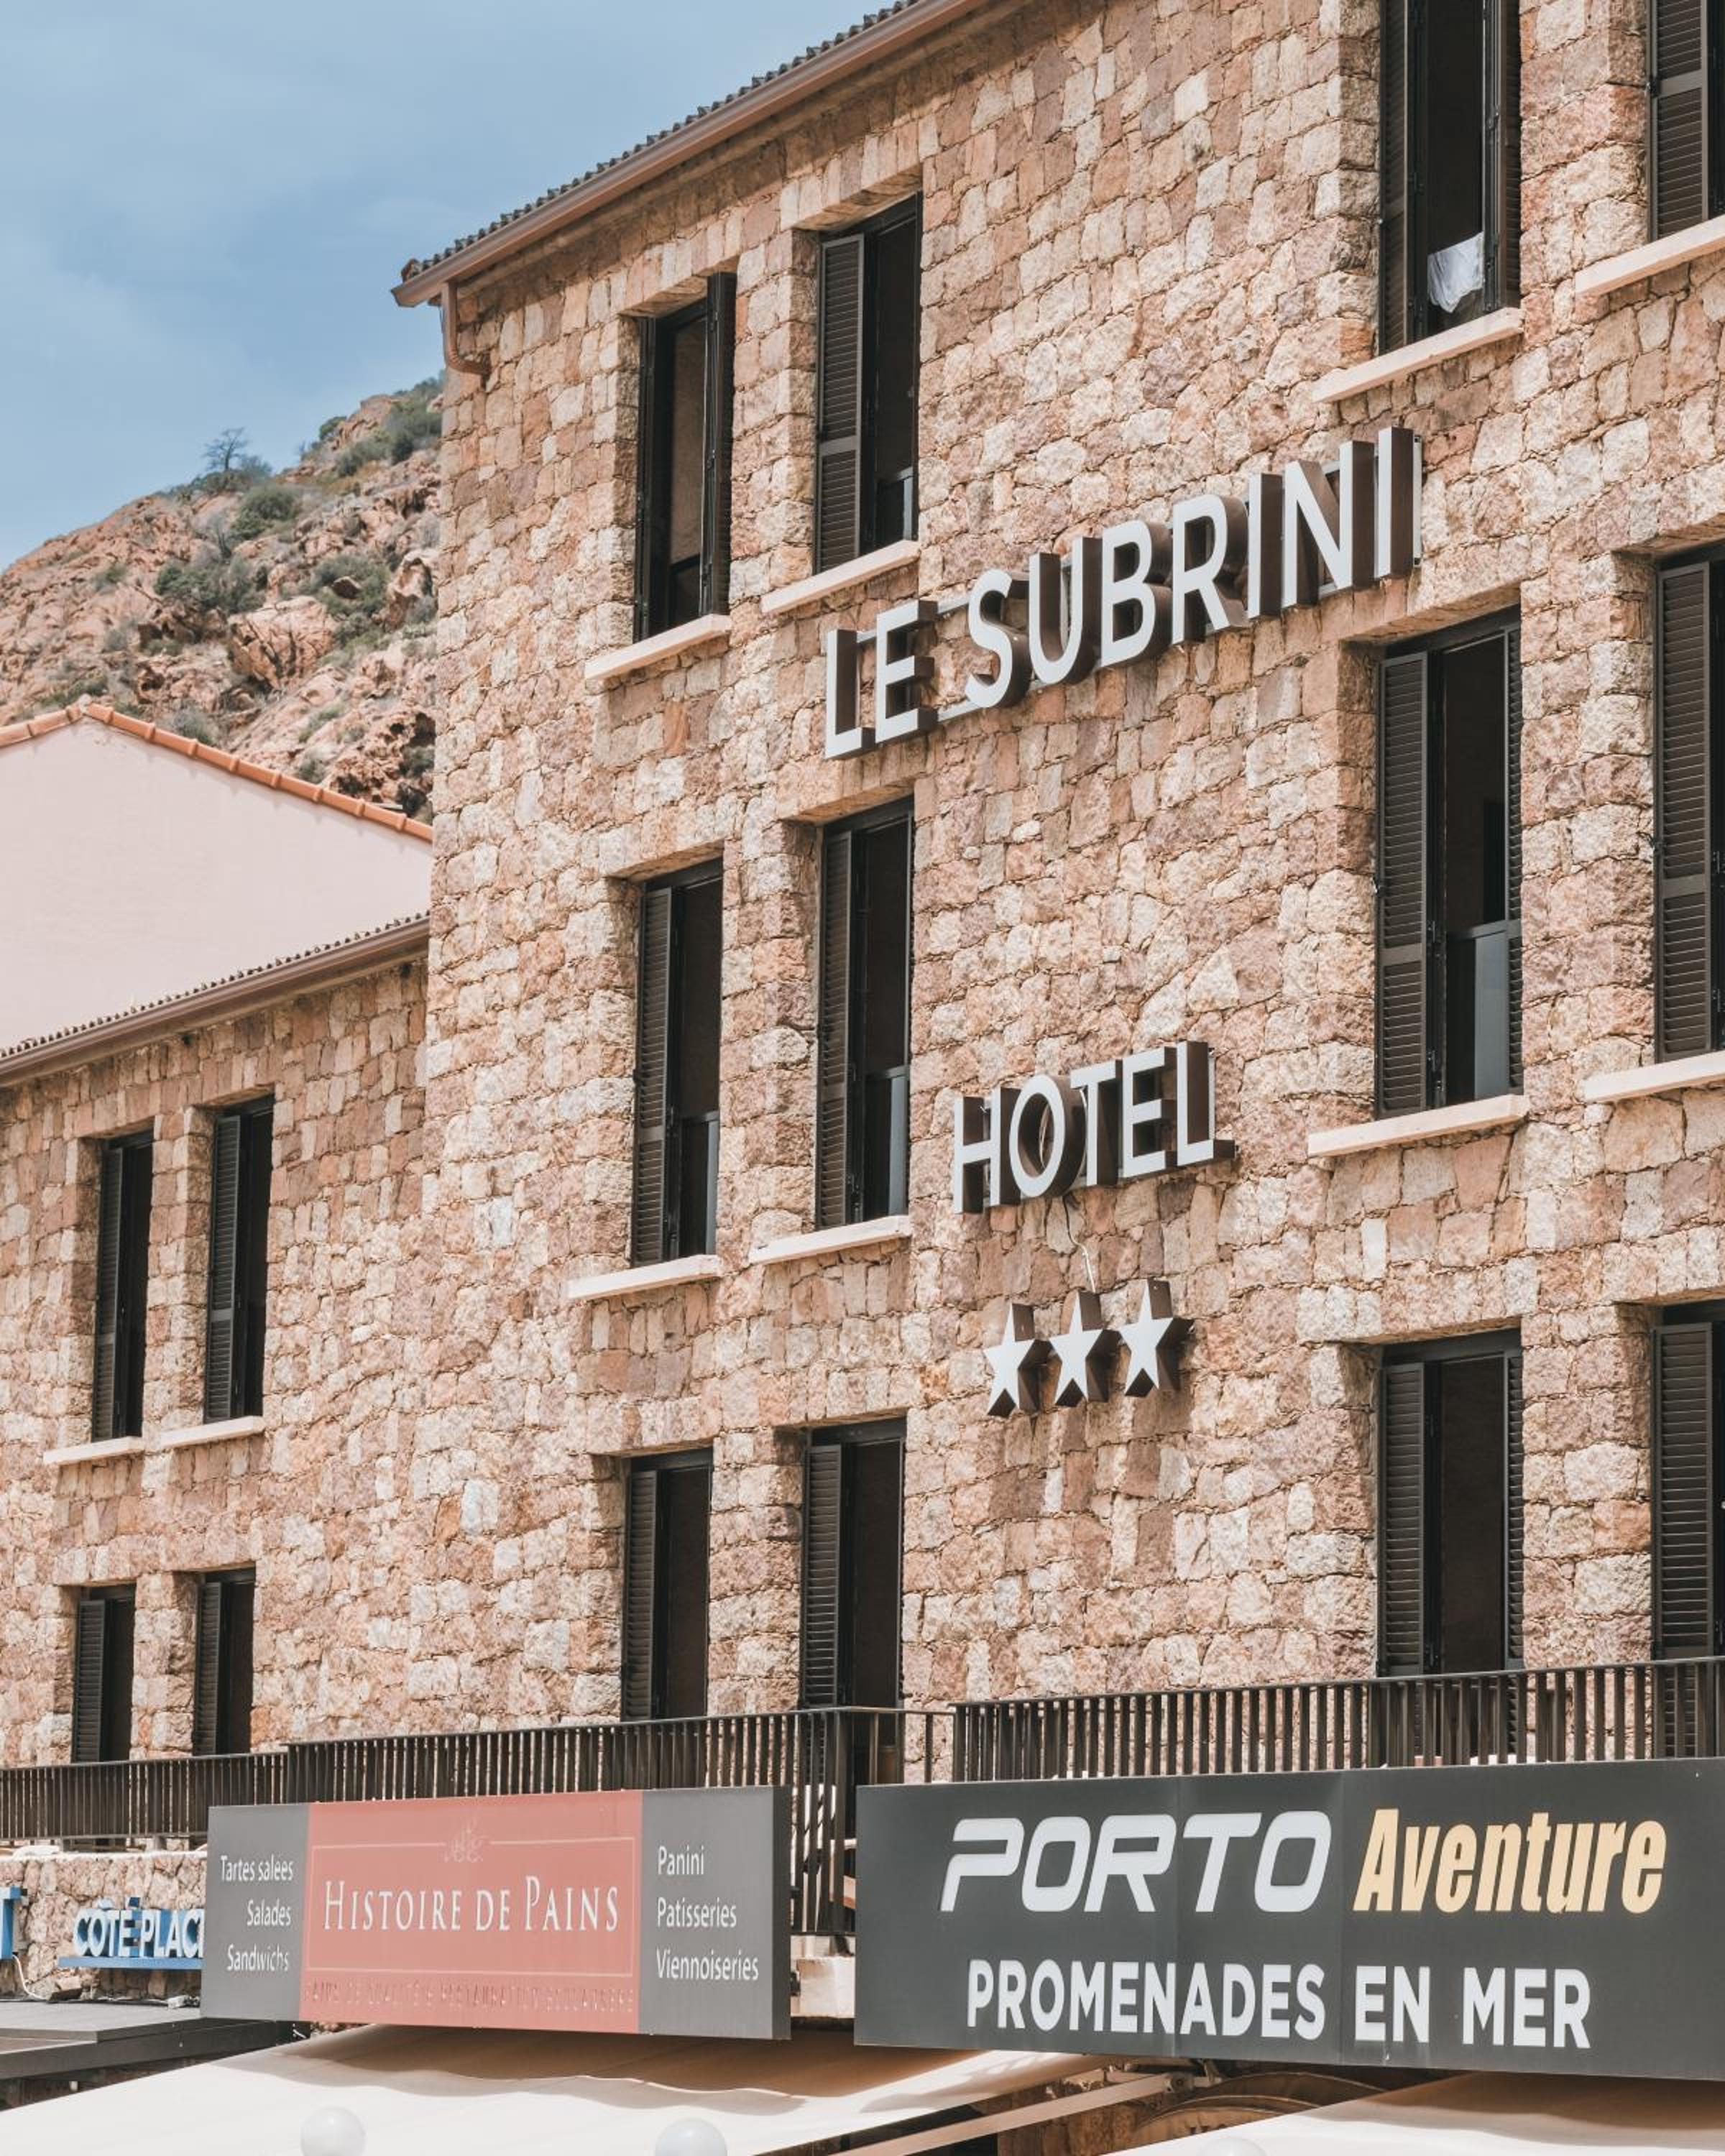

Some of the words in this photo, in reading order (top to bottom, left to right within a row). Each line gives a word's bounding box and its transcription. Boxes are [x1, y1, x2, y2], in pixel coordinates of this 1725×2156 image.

[825, 602, 923, 760] LE
[965, 426, 1400, 709] SUBRINI
[954, 1041, 1218, 1215] HOTEL
[220, 1854, 255, 1881] Tartes
[657, 1845, 704, 1875] Panini
[940, 1810, 1332, 1912] PORTO
[1353, 1808, 1667, 1914] Aventure
[247, 1898, 291, 1926] Salades
[657, 1896, 737, 1927] Patisseries
[226, 1943, 290, 1971] Sandwichs
[656, 1946, 759, 1981] Viennoiseries
[967, 1959, 1325, 2040] PROMENADES
[1355, 1966, 1430, 2043] EN
[1463, 1967, 1591, 2048] MER
